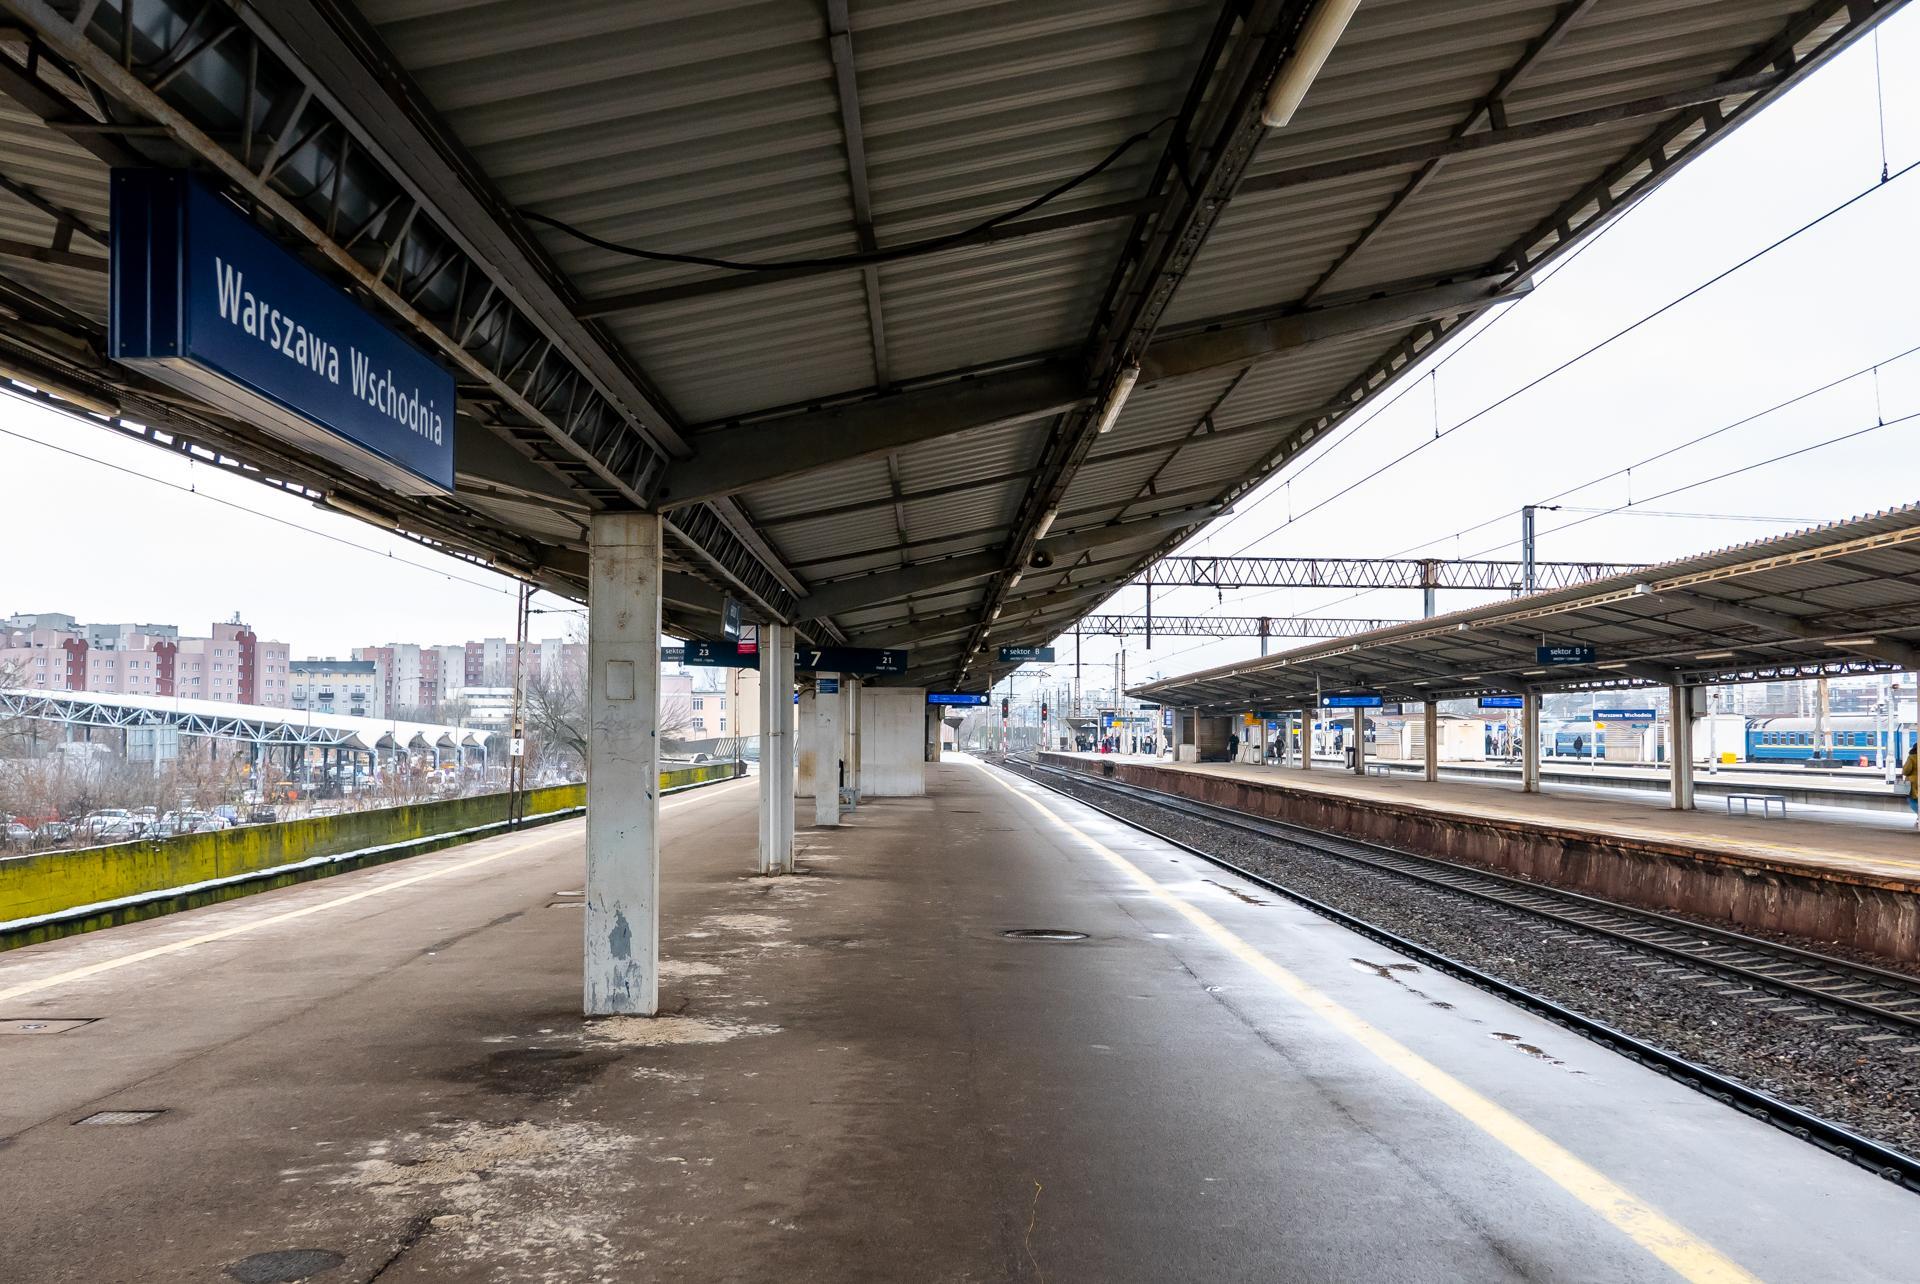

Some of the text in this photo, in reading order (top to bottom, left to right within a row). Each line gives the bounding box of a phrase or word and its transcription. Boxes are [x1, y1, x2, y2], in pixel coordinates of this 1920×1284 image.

[215, 256, 442, 447] Warszawa Wschodnia
[810, 651, 822, 667] 7
[882, 656, 892, 664] 21
